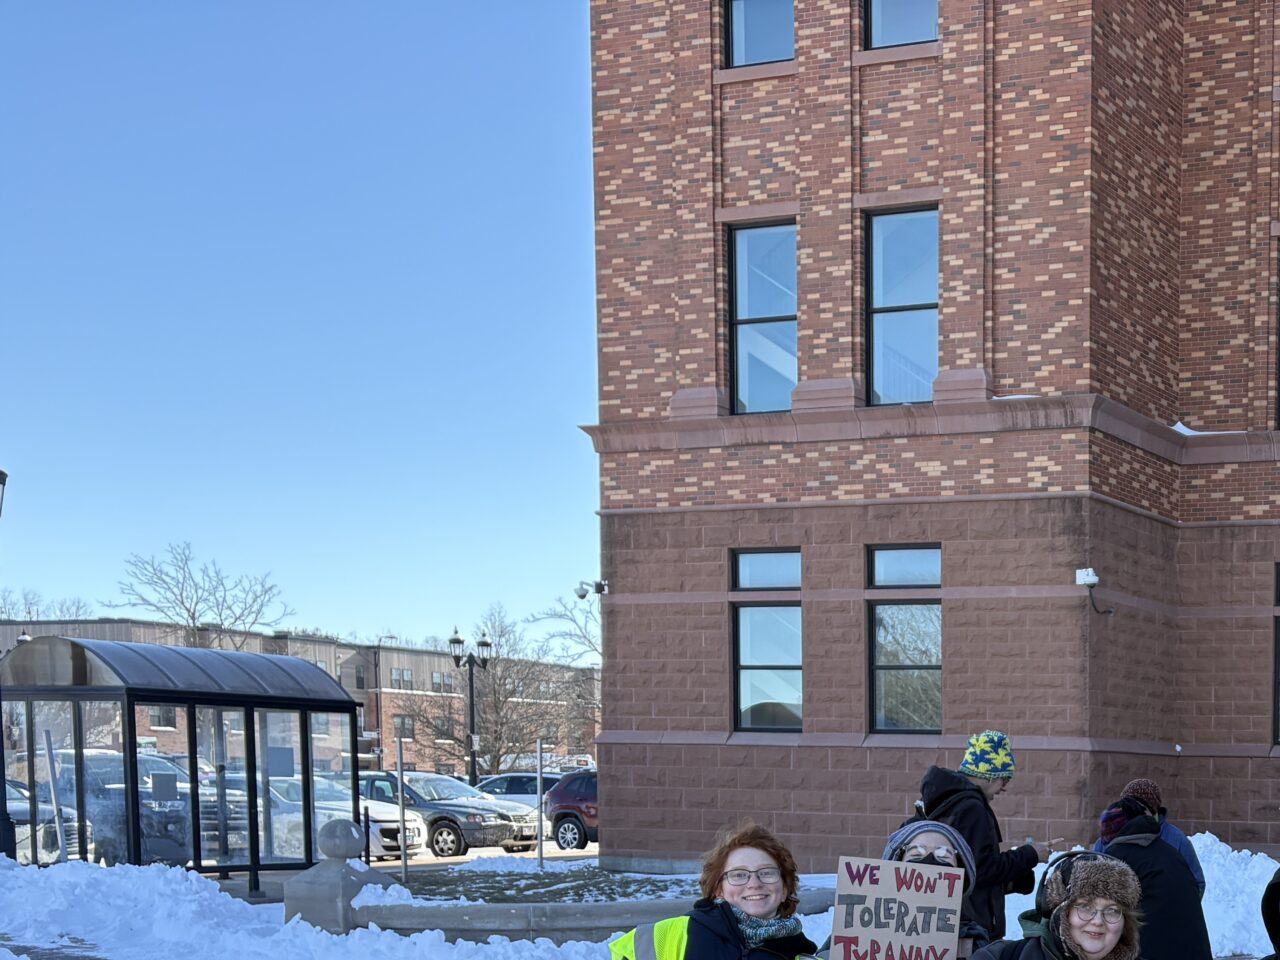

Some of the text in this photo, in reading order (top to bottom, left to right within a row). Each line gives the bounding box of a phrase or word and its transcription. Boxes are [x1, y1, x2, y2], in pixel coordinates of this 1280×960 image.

[845, 861, 961, 898] WE WON'T
[838, 893, 957, 936] TOLERATE
